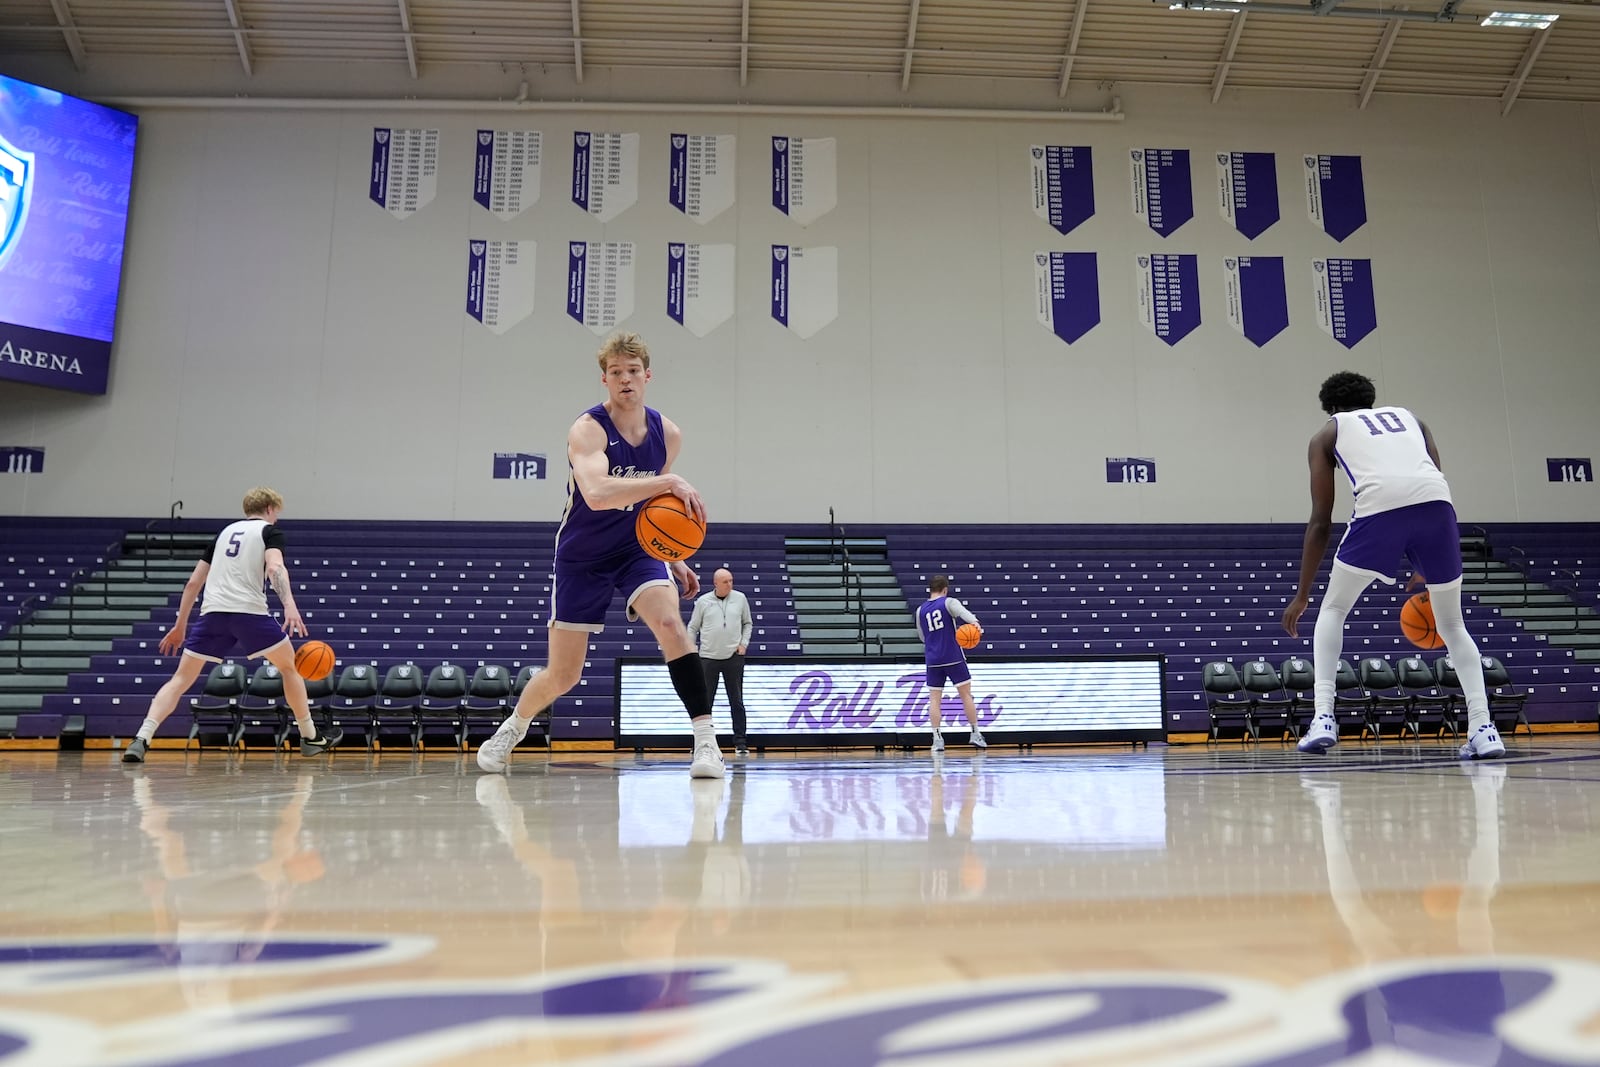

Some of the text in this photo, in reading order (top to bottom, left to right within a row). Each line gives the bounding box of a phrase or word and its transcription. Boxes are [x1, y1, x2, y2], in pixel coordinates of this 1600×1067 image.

[0, 340, 84, 376] ARENA
[1358, 412, 1406, 436] 10
[8, 454, 32, 472] 111
[510, 460, 538, 479] 112
[1122, 465, 1148, 482] 113
[1561, 465, 1586, 482] 114
[225, 532, 245, 558] 5
[651, 538, 682, 558] NCAA
[926, 609, 944, 632] 12
[786, 670, 885, 729] Roll
